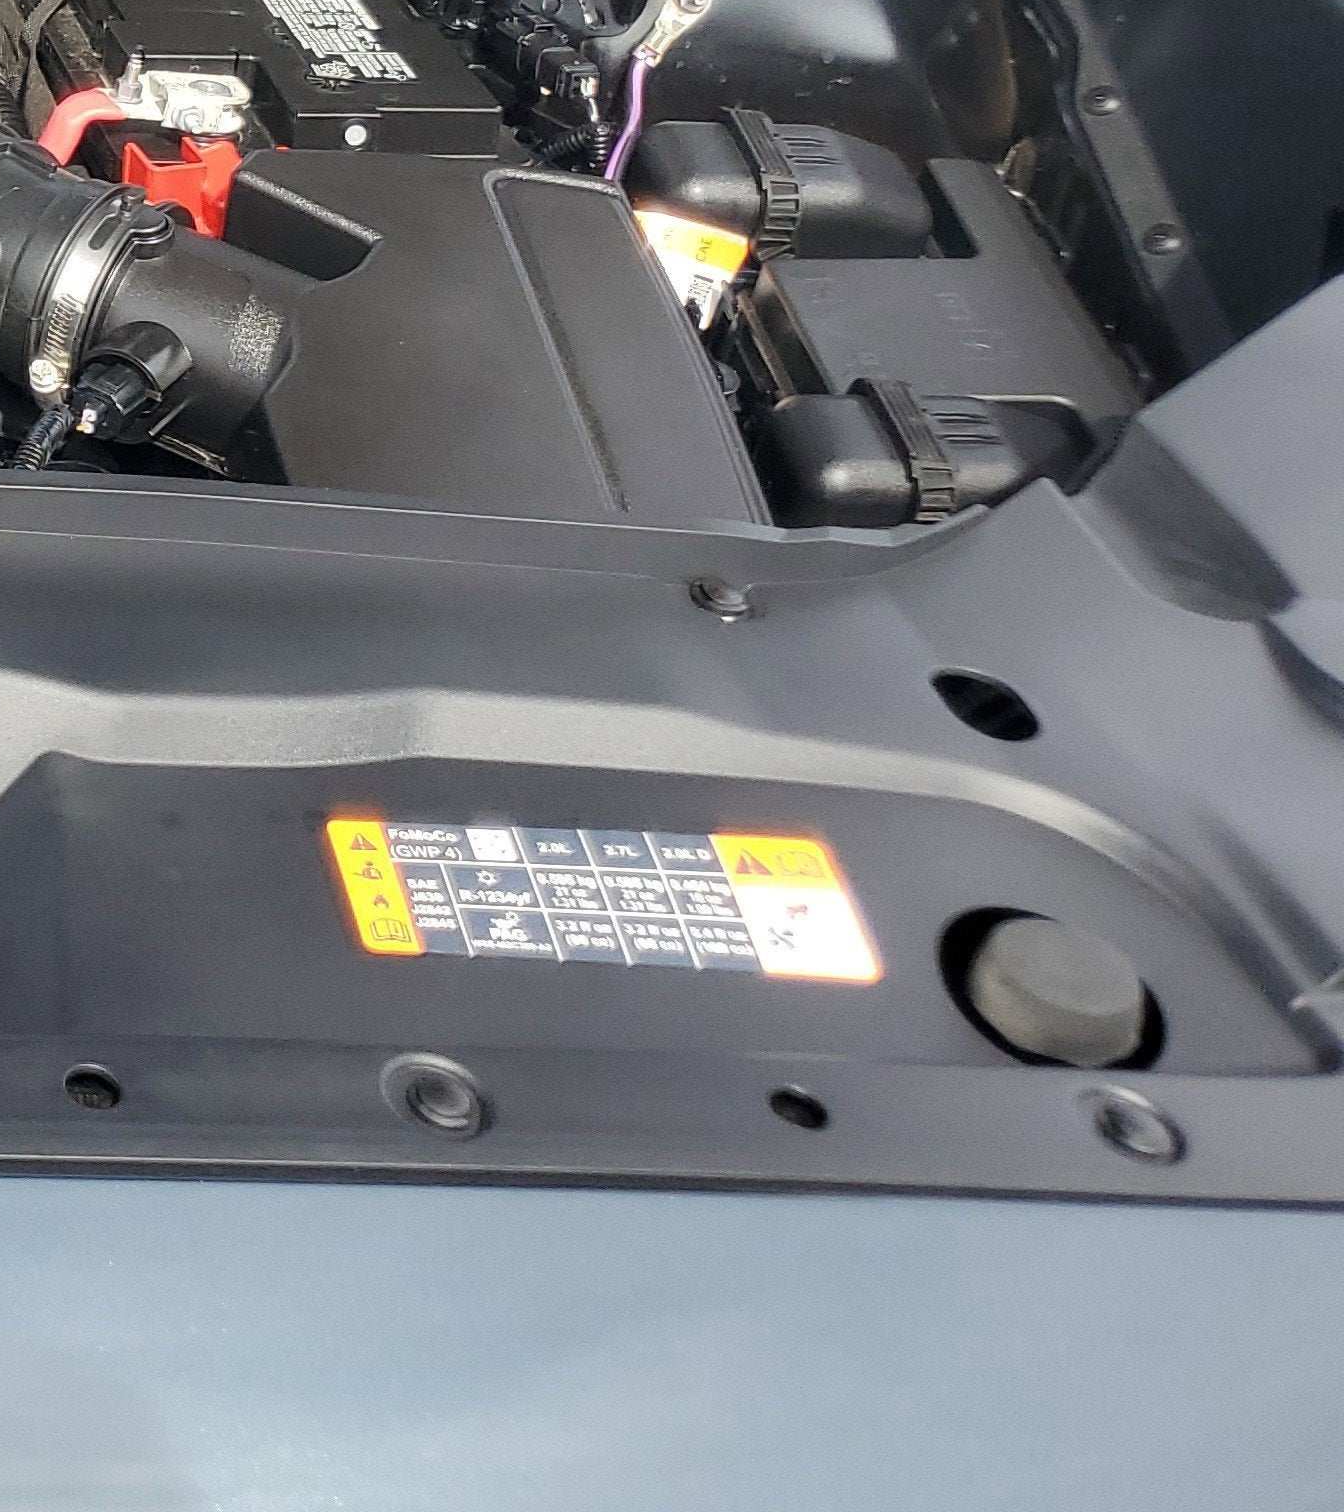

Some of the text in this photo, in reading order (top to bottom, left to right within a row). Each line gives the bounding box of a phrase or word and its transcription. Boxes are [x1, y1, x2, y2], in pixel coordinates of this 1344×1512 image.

[387, 828, 459, 842] FoMoCo
[389, 844, 463, 861] (GWP 4)
[603, 844, 640, 857] 2.7L
[458, 889, 531, 906] R-1234yf
